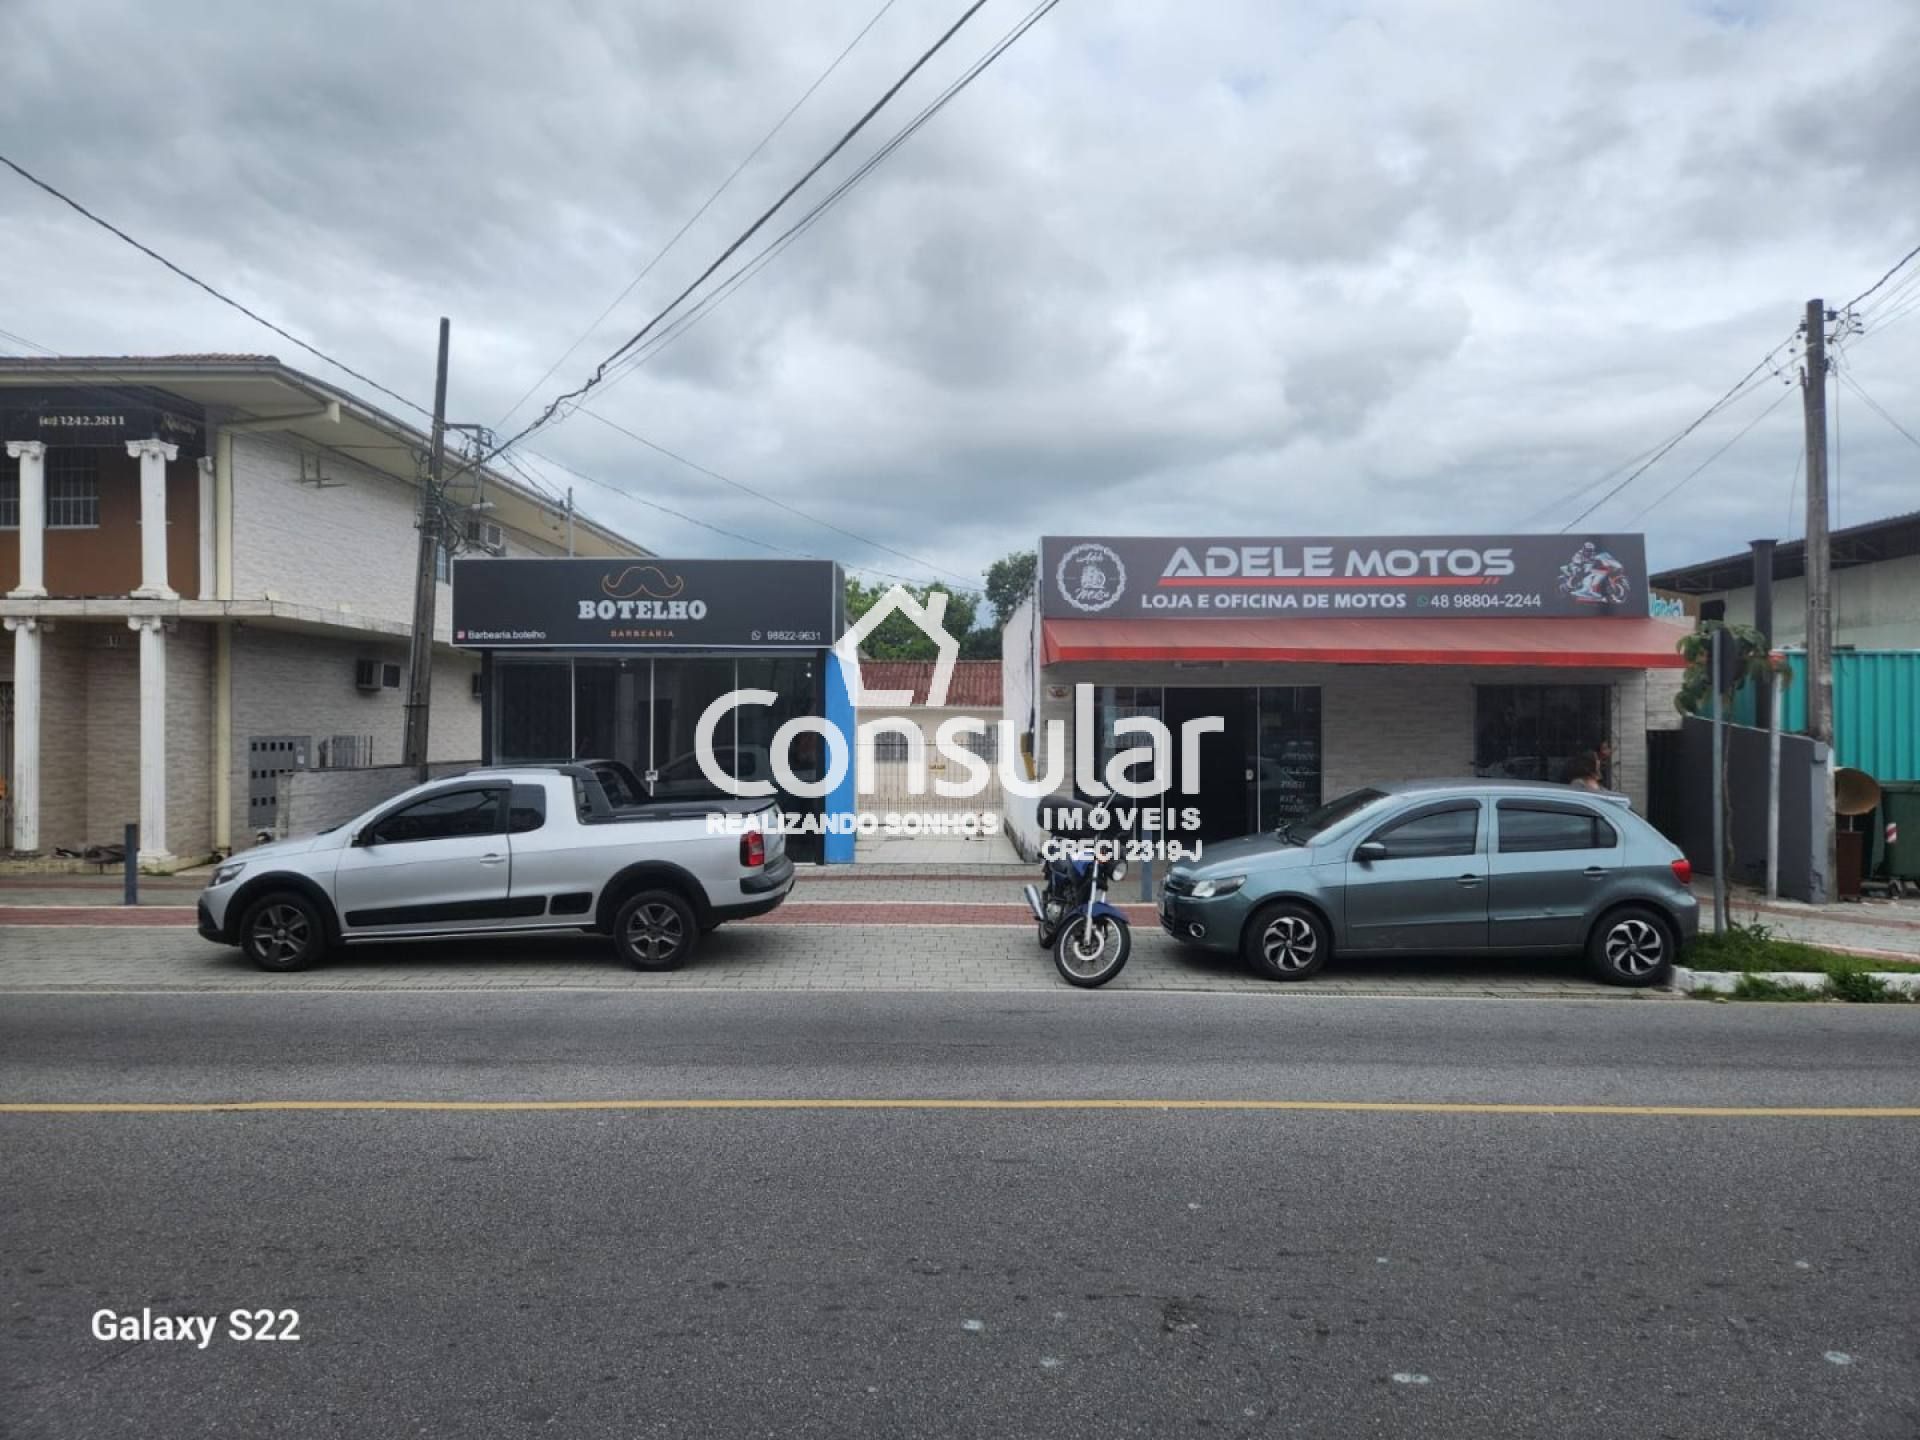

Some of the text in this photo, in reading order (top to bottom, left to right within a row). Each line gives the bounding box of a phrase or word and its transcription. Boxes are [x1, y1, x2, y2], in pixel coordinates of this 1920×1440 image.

[1161, 546, 1516, 577] ADELE MOTOS
[1141, 593, 1407, 609] LOJA E OFICINA DE MOTOS
[1430, 594, 1542, 608] 48 98804-2244
[577, 599, 708, 621] BOTELHO
[610, 629, 675, 638] BARBEARIA
